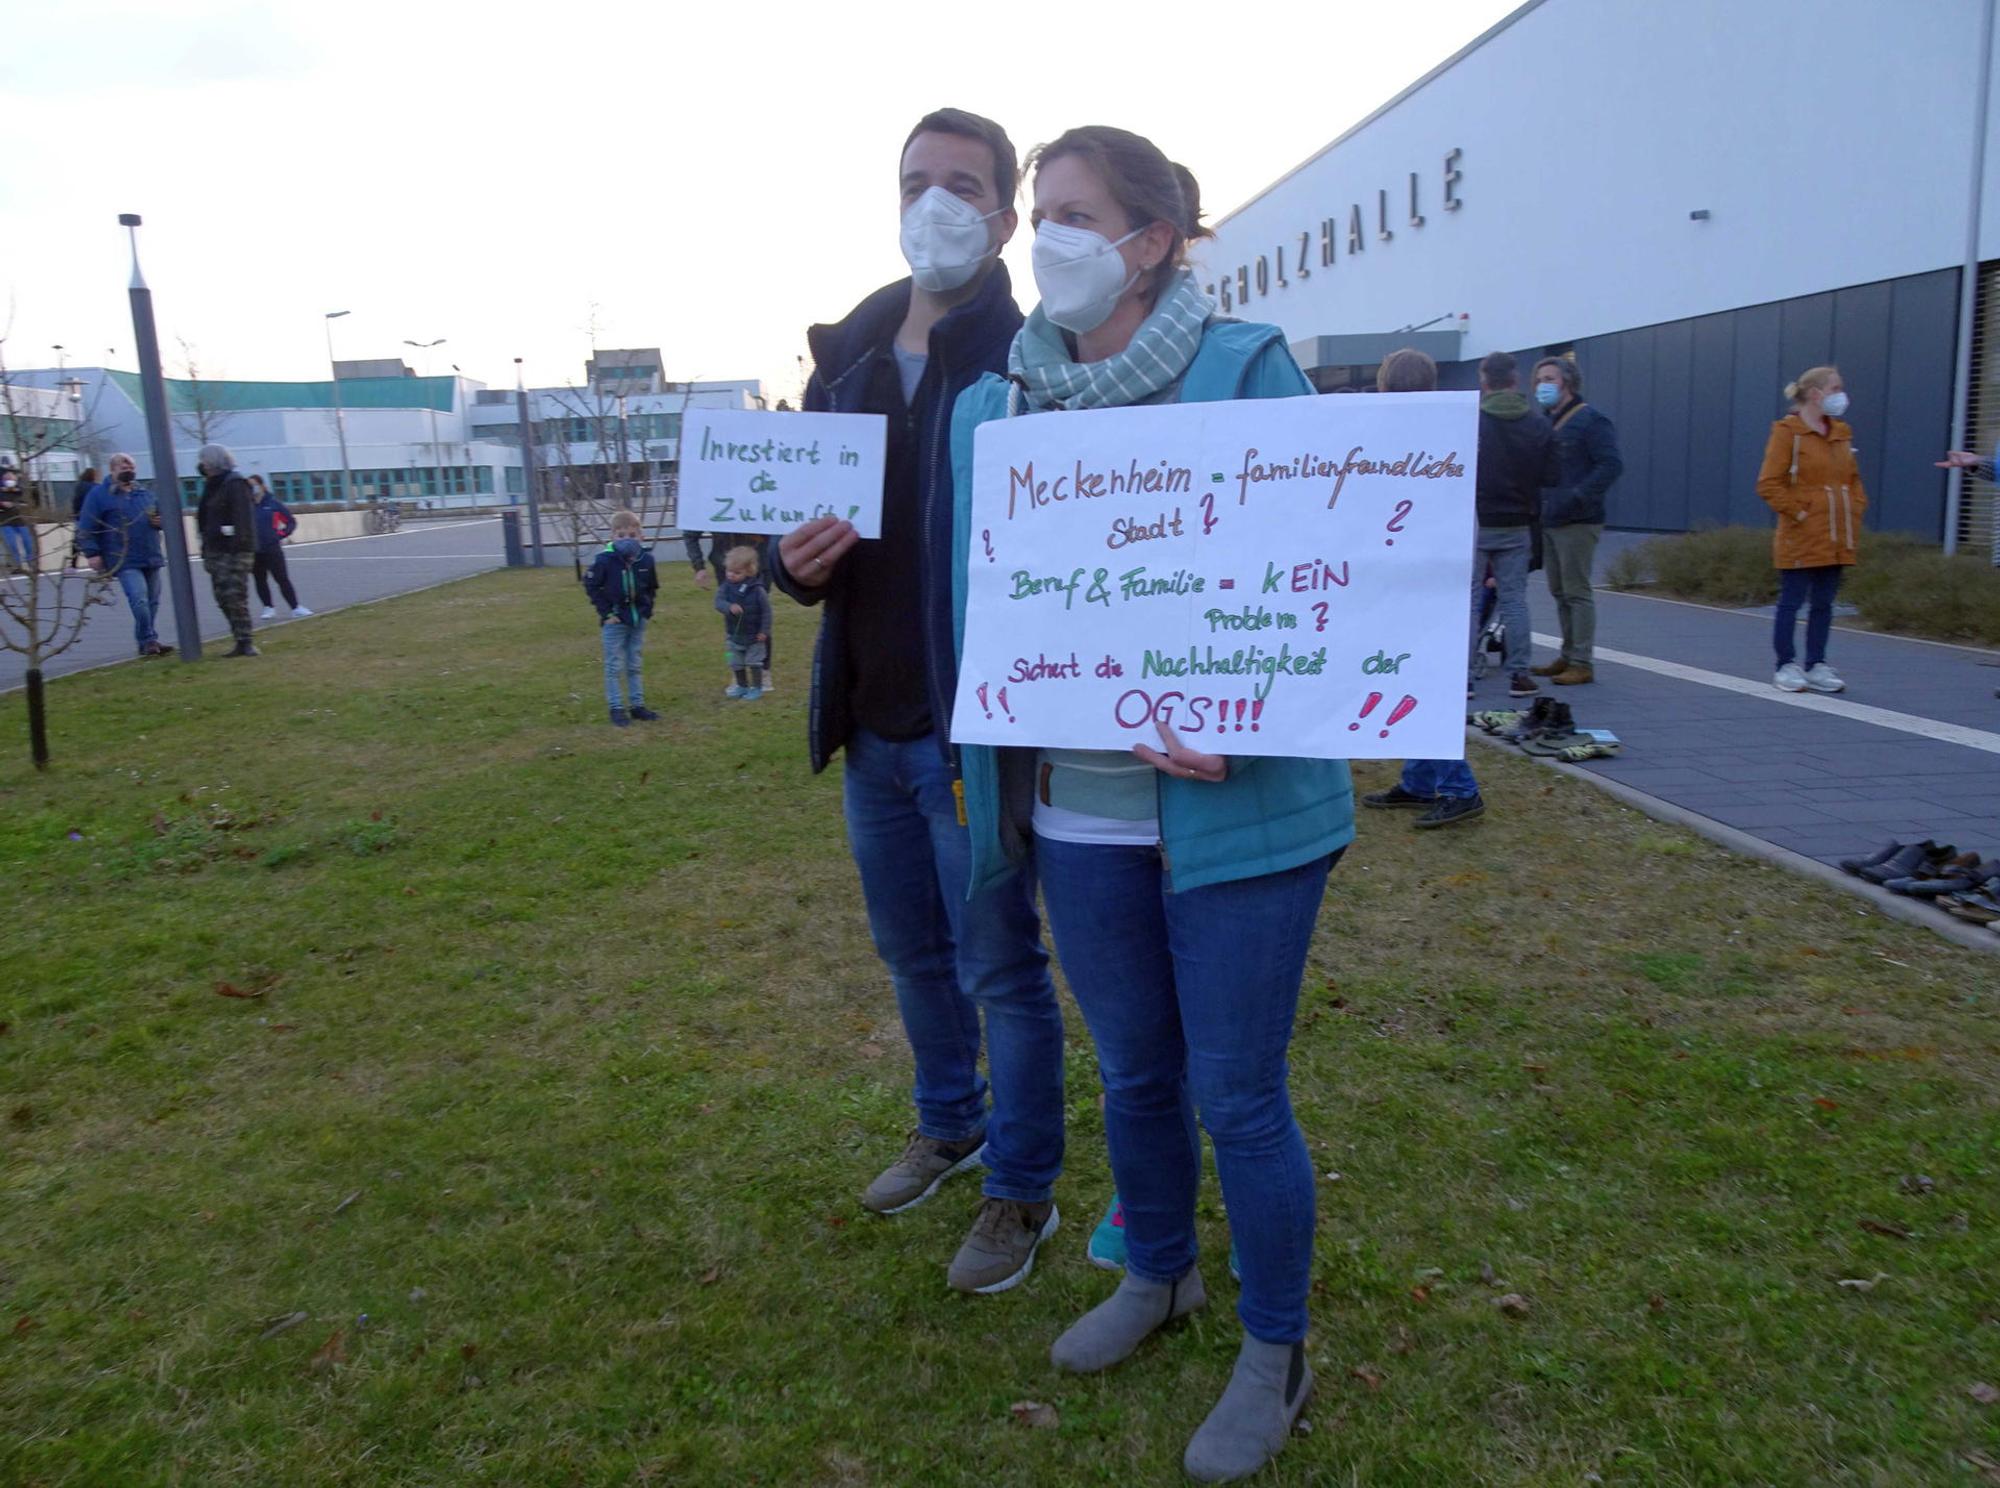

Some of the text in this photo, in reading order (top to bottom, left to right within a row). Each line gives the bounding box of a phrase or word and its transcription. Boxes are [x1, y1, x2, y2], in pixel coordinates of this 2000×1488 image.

[1205, 148, 1463, 313] GHOLZHALLE
[700, 426, 860, 467] Investiert in
[750, 469, 779, 494] die
[1008, 458, 1192, 520] Meckenheim
[1107, 507, 1185, 550] Stadt
[1009, 567, 1085, 610] Beruf
[1086, 567, 1112, 608] &
[1118, 566, 1205, 602] Familie
[1204, 605, 1298, 634] Problem
[1008, 643, 1412, 700] Sichert die Nachhaltigkeit der
